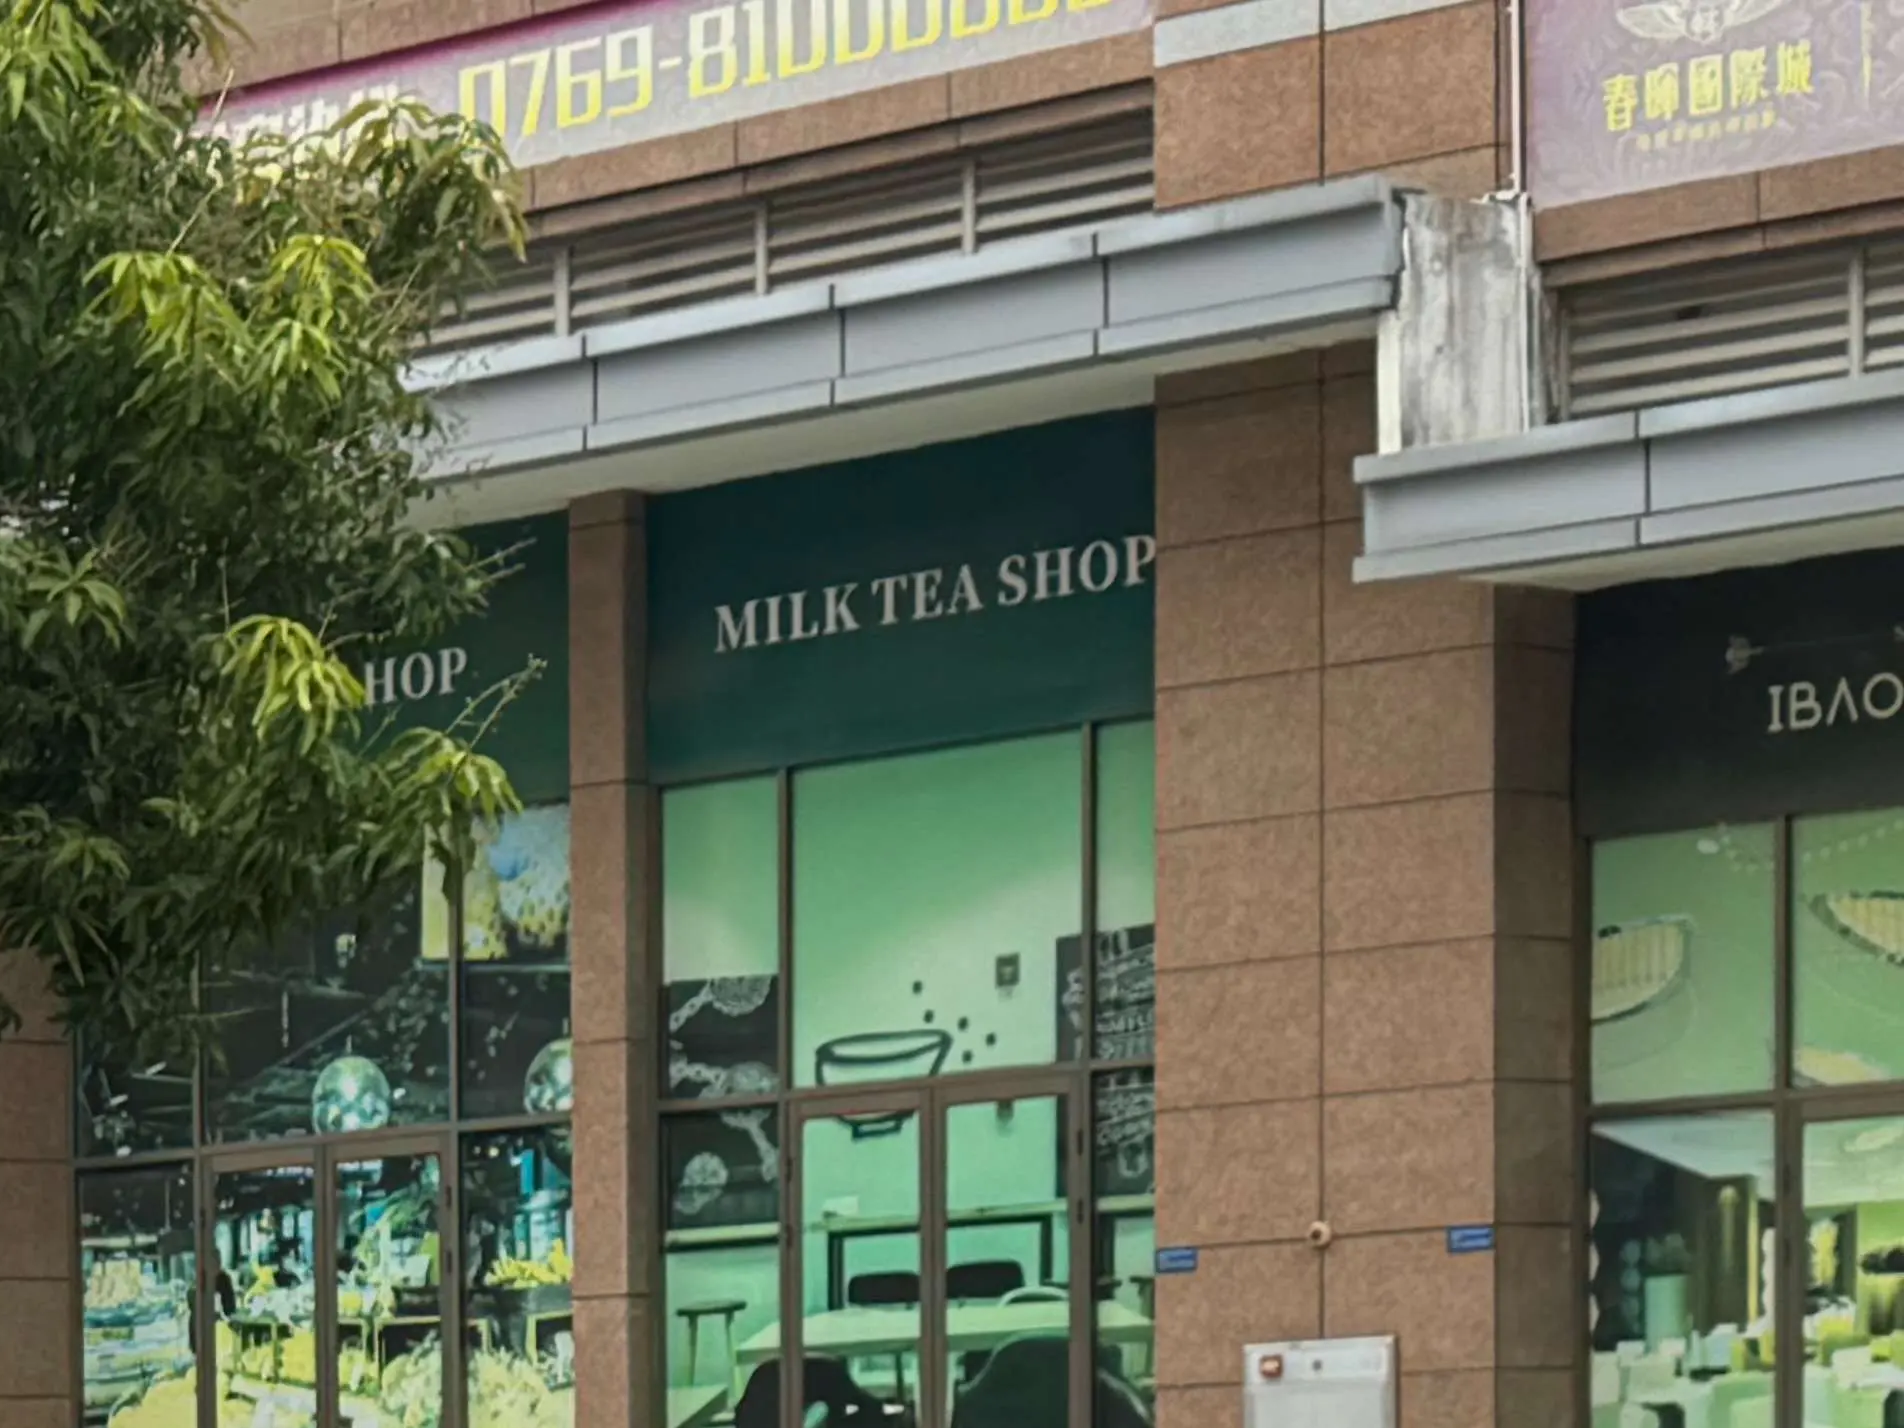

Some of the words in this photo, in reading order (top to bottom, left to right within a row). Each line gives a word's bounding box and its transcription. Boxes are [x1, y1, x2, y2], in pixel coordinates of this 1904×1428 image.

[713, 582, 860, 653] MILK
[871, 563, 985, 626] TEA
[996, 534, 1156, 607] SHOP
[364, 647, 468, 706] HOP
